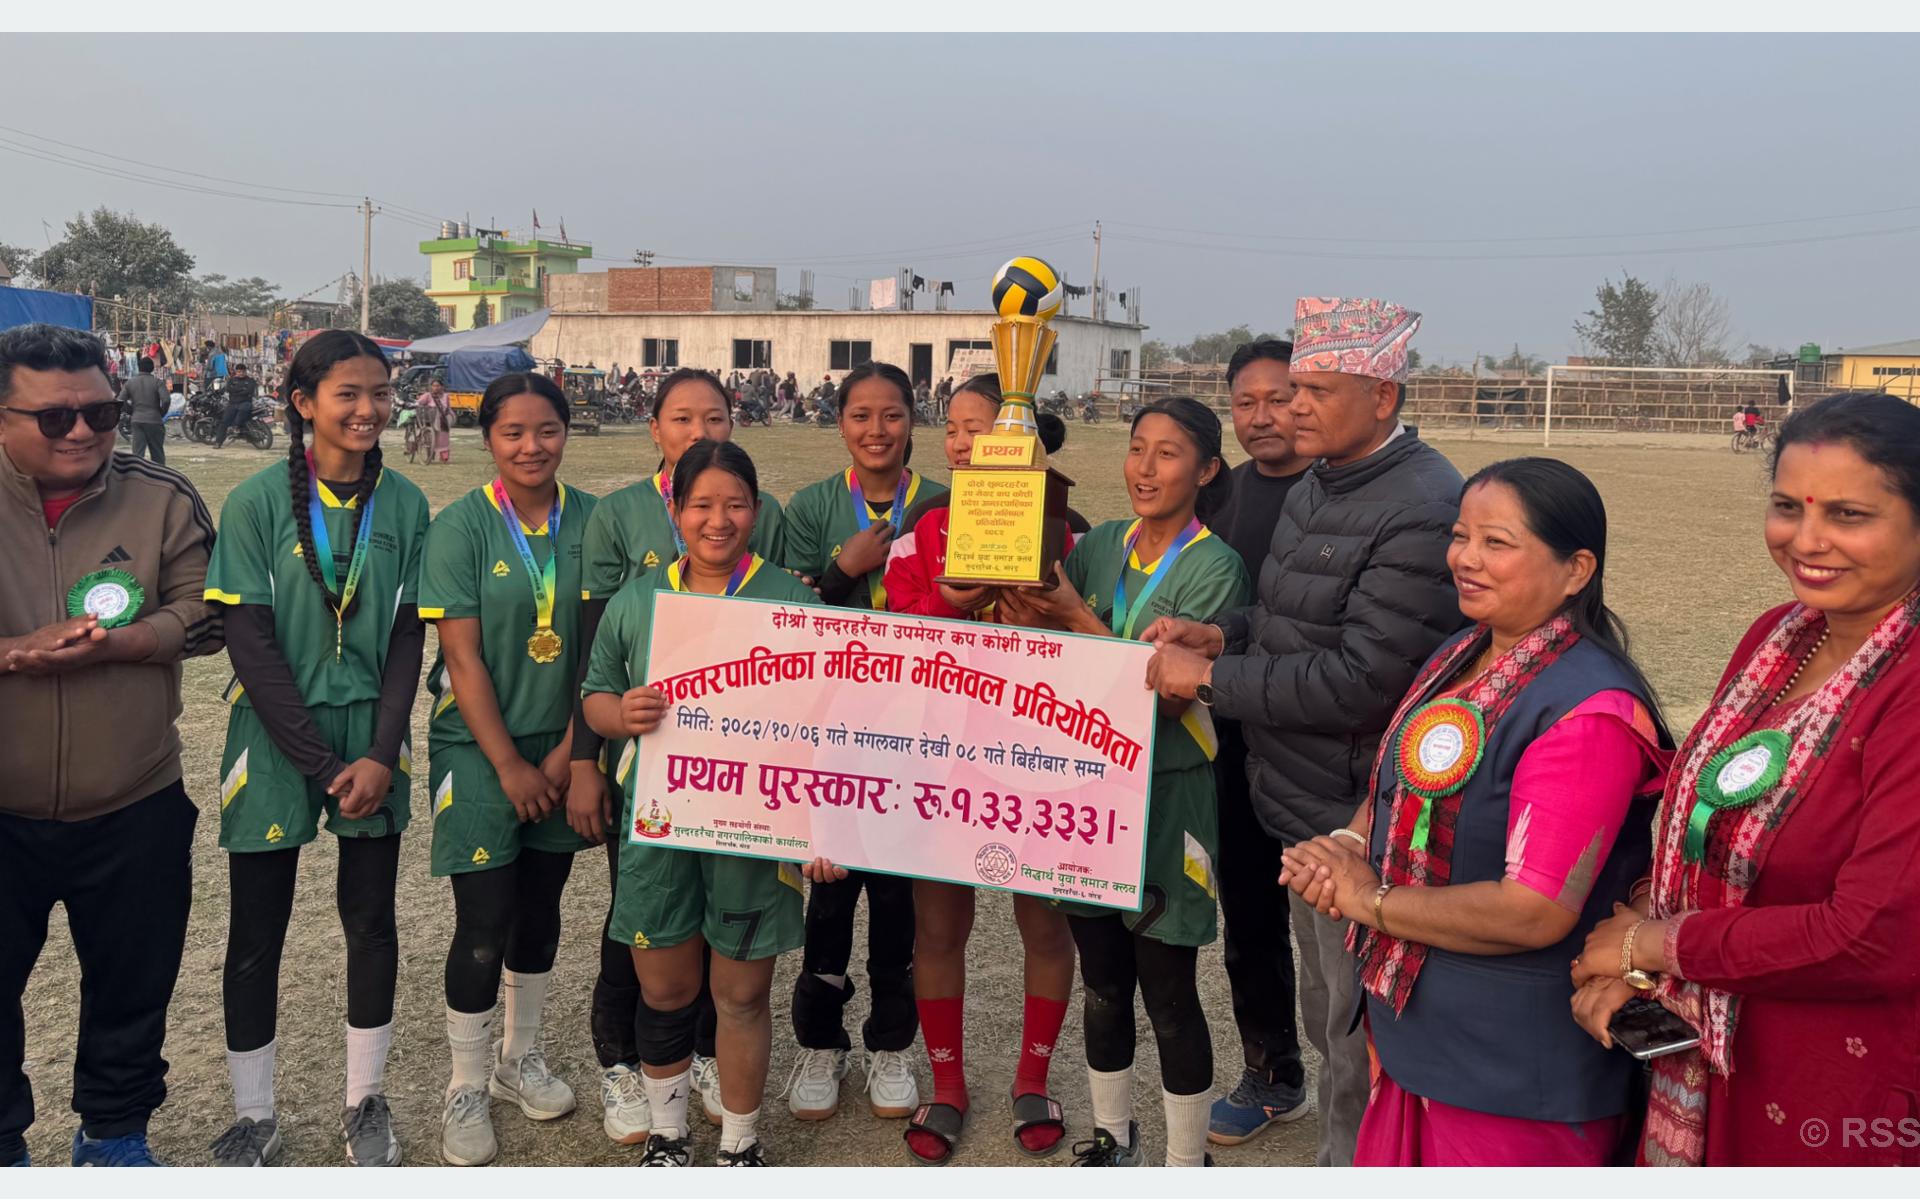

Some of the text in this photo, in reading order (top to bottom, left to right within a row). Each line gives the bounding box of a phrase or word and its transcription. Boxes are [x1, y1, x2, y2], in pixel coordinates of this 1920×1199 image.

[982, 445, 1024, 457] प्रथम
[772, 607, 807, 629] दोश्रो
[893, 621, 945, 644] उपमेयर
[951, 630, 976, 648] कप
[982, 629, 1019, 652] कोशी
[1026, 635, 1063, 660] प्रदेश
[649, 640, 1143, 773] अन्तरपालिका महिला भलिवल प्रतियोगिता
[721, 717, 820, 747] २०८२/१०/०६
[826, 722, 848, 746] गते
[853, 726, 914, 755] मंगलवार
[919, 733, 950, 759] देखी
[956, 744, 977, 762] ०८
[983, 742, 1005, 766] गते
[1011, 746, 1069, 776] बिहीबार
[1074, 759, 1106, 780] सम्म
[667, 754, 748, 796] प्रथम
[717, 831, 774, 845] नगरपालिकाको
[775, 836, 809, 849] कार्यालय
[1020, 864, 1054, 882] सिद्धार्थ
[1057, 873, 1076, 887] युवा
[1080, 877, 1108, 890] समाज
[720, 908, 765, 961] 7
